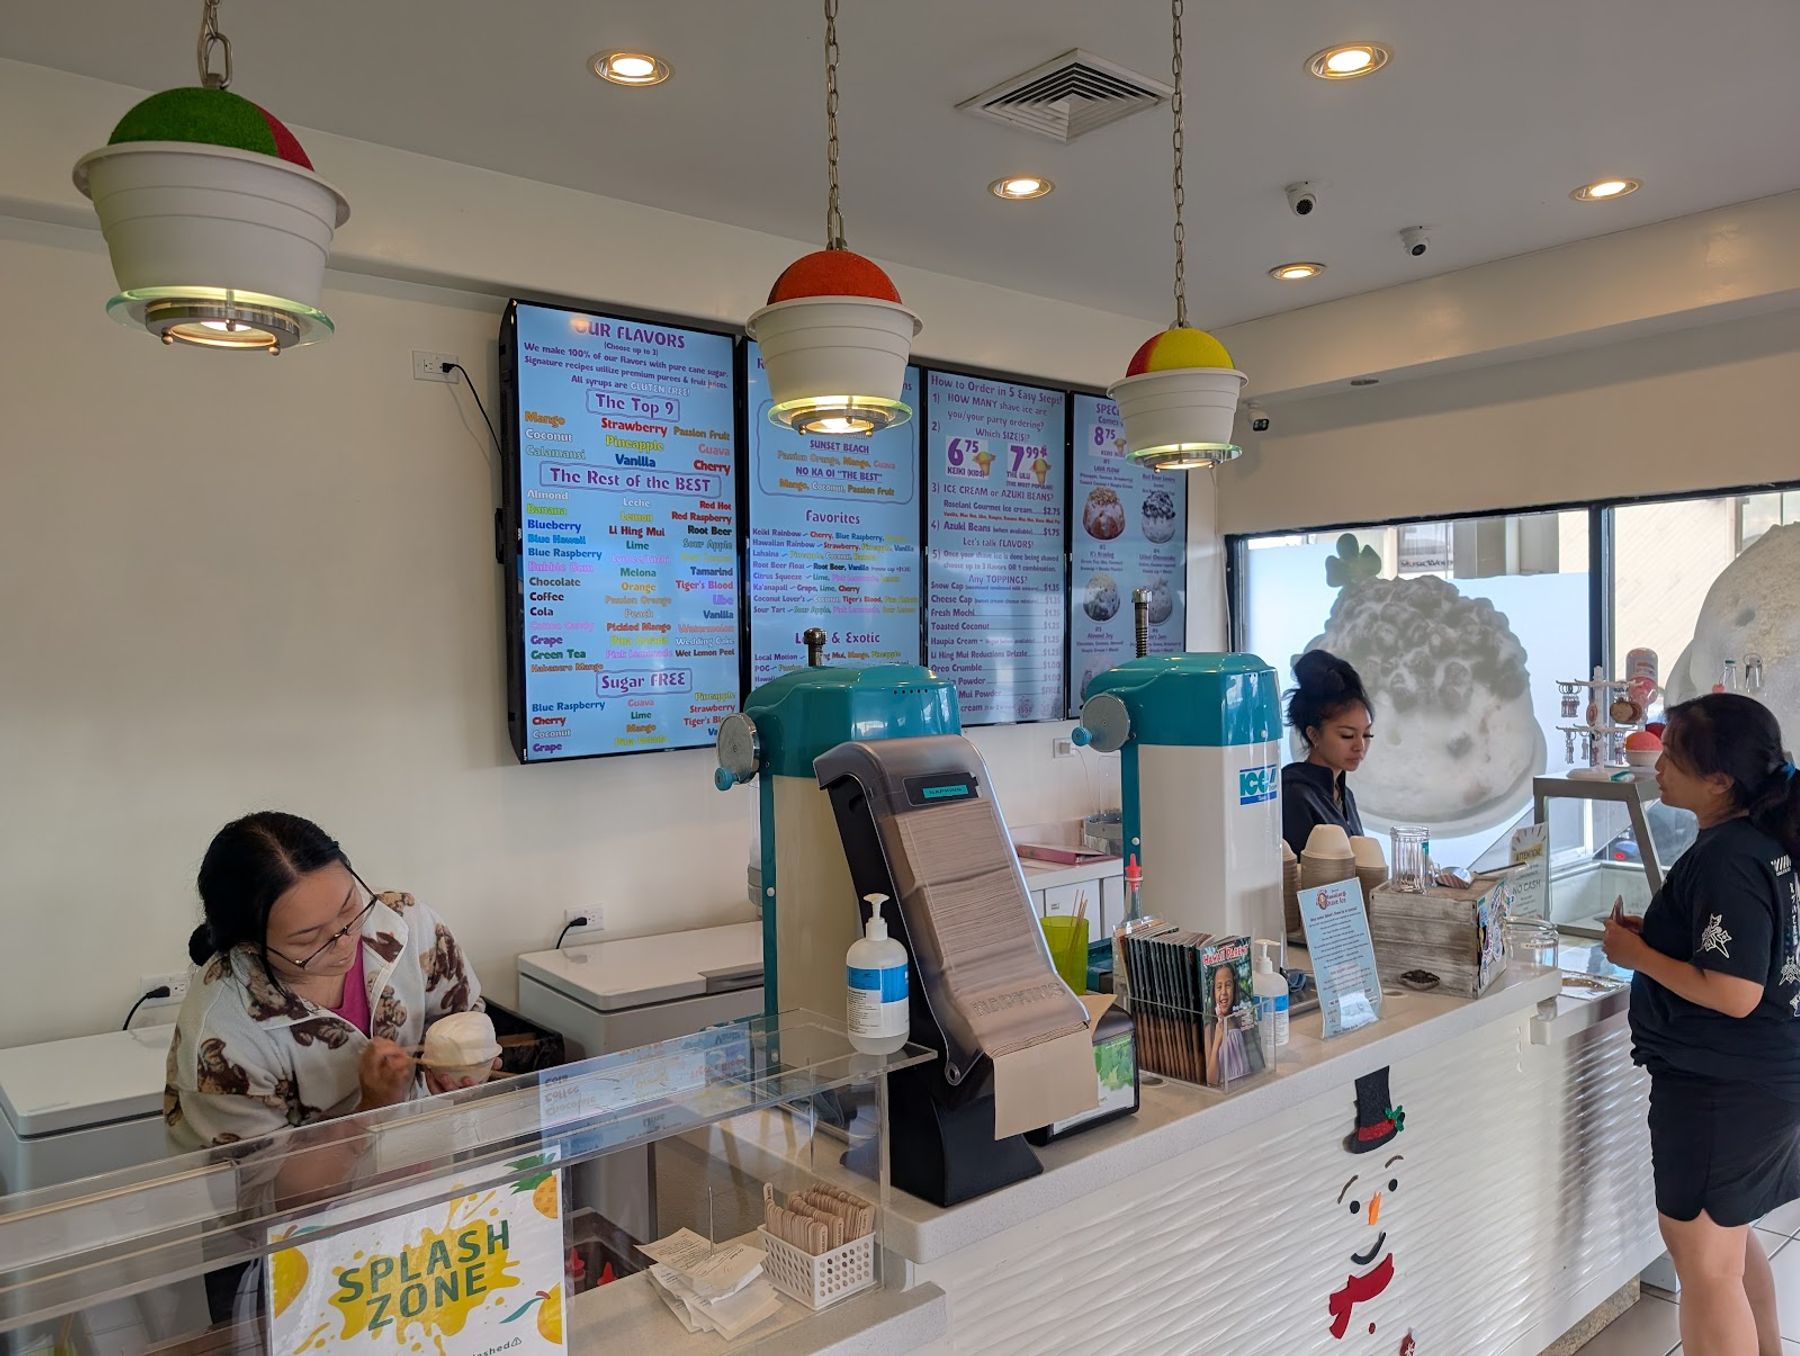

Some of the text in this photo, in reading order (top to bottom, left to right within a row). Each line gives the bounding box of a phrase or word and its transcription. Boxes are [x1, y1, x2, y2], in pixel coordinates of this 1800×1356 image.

[616, 326, 685, 349] FLAVORS
[523, 342, 706, 374] We make 100% of our flavors with pure cane
[524, 355, 656, 379] Signature recipes utilize premium
[571, 374, 665, 393] All syrups are GLUTEN
[931, 375, 1037, 403] How to Order in 5 Easy
[595, 393, 674, 418] The Top 9
[948, 393, 998, 408] HOW MANY
[524, 411, 567, 428] Mango
[986, 416, 1008, 426] party
[600, 417, 668, 438] Strawberry
[673, 425, 731, 441] Passion Fruit
[975, 428, 1000, 438] Which
[525, 428, 573, 442] Coconut
[1094, 426, 1116, 446] 8 75
[605, 434, 665, 454] Pineapple
[698, 443, 731, 456] Guava
[810, 440, 870, 453] SUNSET BEACH
[526, 445, 587, 460] Calamansi
[947, 438, 979, 466] 6 75
[615, 453, 656, 468] Vanilla
[1010, 445, 1025, 472] 7
[693, 459, 731, 476] Cherry
[795, 466, 809, 475] NO
[811, 467, 824, 477] KA
[825, 469, 835, 477] OI
[549, 467, 711, 492] The Rest of the BEST
[527, 489, 569, 500] Almond
[944, 484, 1025, 499] ICE CREAM AZUKI
[623, 498, 651, 508] Leche
[699, 500, 732, 510] Red Hot
[671, 511, 732, 525] Red Raspberry
[806, 510, 860, 525] Favorites
[527, 519, 582, 534] Blueberry
[608, 525, 666, 539] Li Hing Mui
[687, 525, 733, 536] Root Beer
[943, 521, 991, 532] Azuki Beans
[527, 534, 551, 544] Blue
[752, 528, 850, 540] Keiki Rainbow Blue
[626, 540, 650, 551] Lime
[752, 539, 816, 548] Hawaiian Rainbow
[527, 548, 551, 557] Blue
[553, 549, 603, 561] Raspberry
[620, 567, 657, 578] Melona
[690, 566, 734, 576] Tamarind
[529, 577, 581, 588] Chocolate
[621, 582, 657, 594] Orange
[675, 580, 734, 592] Tiger's Blood
[930, 581, 950, 590] Snow
[951, 582, 965, 591] Cap
[529, 592, 565, 602] Coffee
[930, 594, 958, 604] Cheese
[959, 595, 973, 605] Cap
[529, 607, 554, 617] Cola
[703, 610, 734, 620] Vanilla
[753, 606, 769, 614] Sour
[930, 608, 951, 617] Fresh
[641, 622, 672, 634] Mango
[930, 621, 990, 631] Toasted Coconut
[530, 635, 564, 648] Grape
[845, 632, 881, 644] Exotic
[956, 636, 978, 645] Cream
[530, 649, 587, 660] Green Tea
[693, 648, 735, 657] Lemon Peel
[754, 652, 798, 661] Local Motion
[951, 663, 983, 672] Crumble
[602, 672, 686, 693] Sugar FREE
[957, 677, 987, 686] Powder
[532, 701, 606, 713] Blue Raspberry
[689, 703, 736, 714] Strawberry
[630, 711, 652, 719] Lime
[532, 716, 567, 727] Cherry
[683, 716, 710, 728] Tiger's
[532, 730, 572, 739] Coconut
[532, 743, 563, 754] Grape
[338, 1219, 510, 1303] SPLASH
[367, 1261, 488, 1332] ZONE
